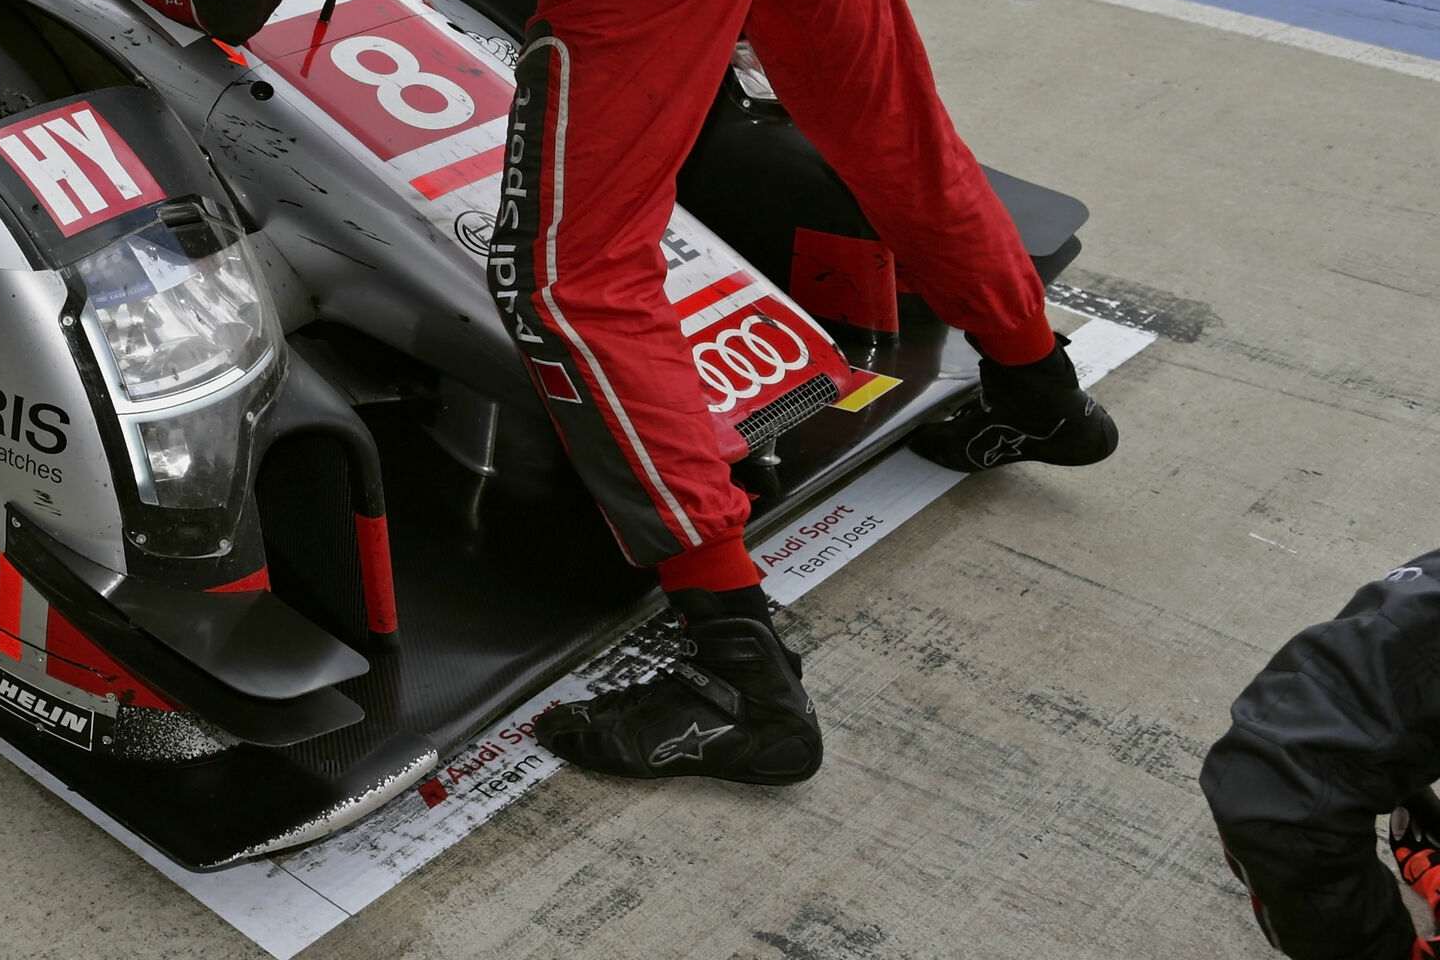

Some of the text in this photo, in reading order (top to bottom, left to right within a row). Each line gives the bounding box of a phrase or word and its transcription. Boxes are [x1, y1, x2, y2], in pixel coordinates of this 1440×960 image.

[330, 35, 476, 130] 8
[760, 505, 855, 568] Audi Sport
[784, 515, 884, 578] Team Joest
[446, 741, 505, 785] Audi
[468, 754, 544, 799] Team
